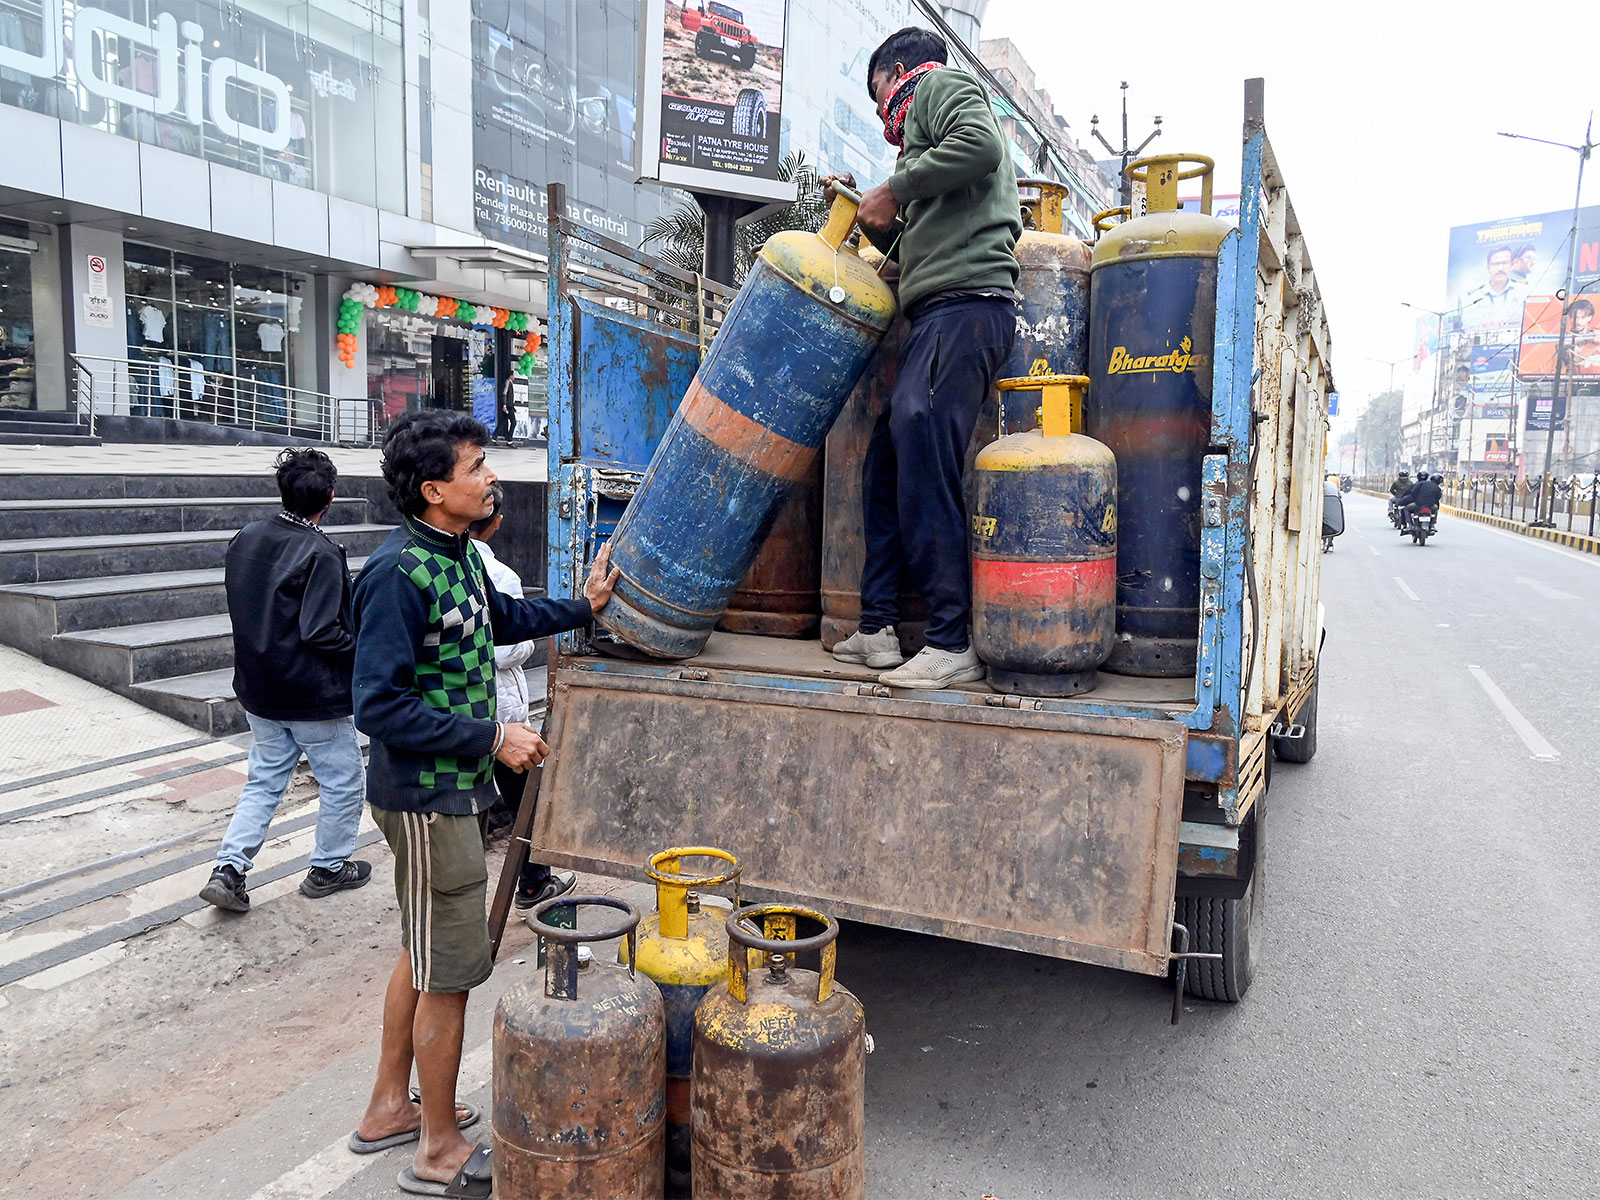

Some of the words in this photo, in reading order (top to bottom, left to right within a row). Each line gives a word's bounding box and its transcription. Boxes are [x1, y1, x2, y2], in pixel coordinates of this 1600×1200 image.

[698, 135, 722, 147] PATNA
[723, 138, 743, 150] TYRE
[744, 142, 769, 154] HOUSE
[474, 191, 509, 212] Pandey
[475, 169, 536, 208] Renault
[583, 204, 628, 237] Central
[474, 206, 491, 221] Tel.
[494, 212, 548, 238] 7360002216
